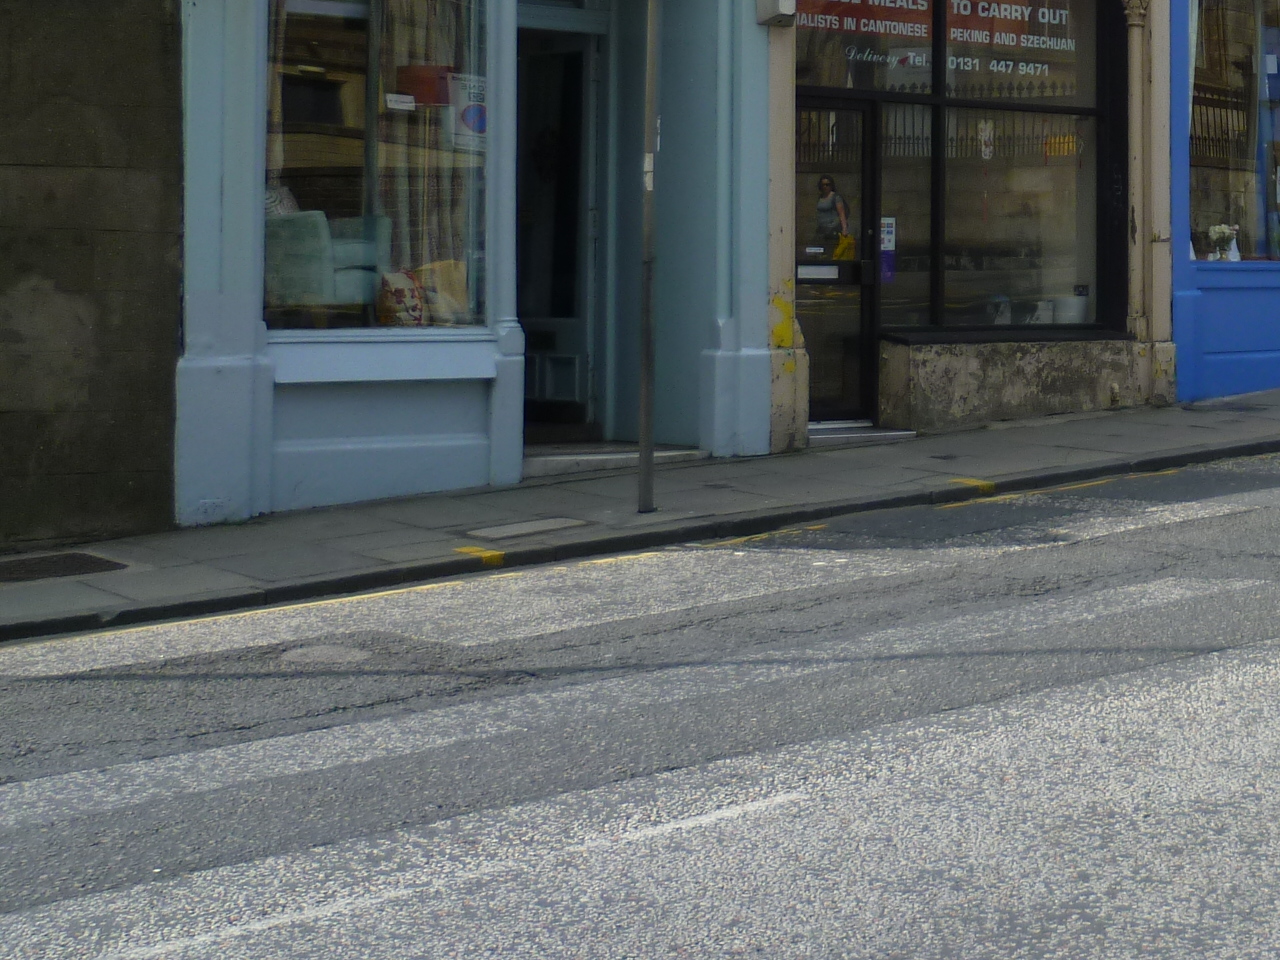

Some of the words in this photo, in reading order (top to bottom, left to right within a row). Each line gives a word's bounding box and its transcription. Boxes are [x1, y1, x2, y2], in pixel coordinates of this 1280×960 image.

[977, 1, 1033, 22] CARRY
[1038, 7, 1070, 25] OUT
[796, 13, 840, 29] IALISTS
[843, 16, 857, 31] IN
[860, 18, 928, 38] CANTONESE
[950, 27, 990, 43] PEKING
[993, 31, 1017, 46] AND
[1020, 34, 1076, 52] SZECHUAN
[845, 45, 900, 69] Delivery
[907, 51, 930, 67] Tel.
[948, 56, 980, 71] 0131
[989, 59, 1014, 74] 447
[1018, 62, 1049, 77] 9471
